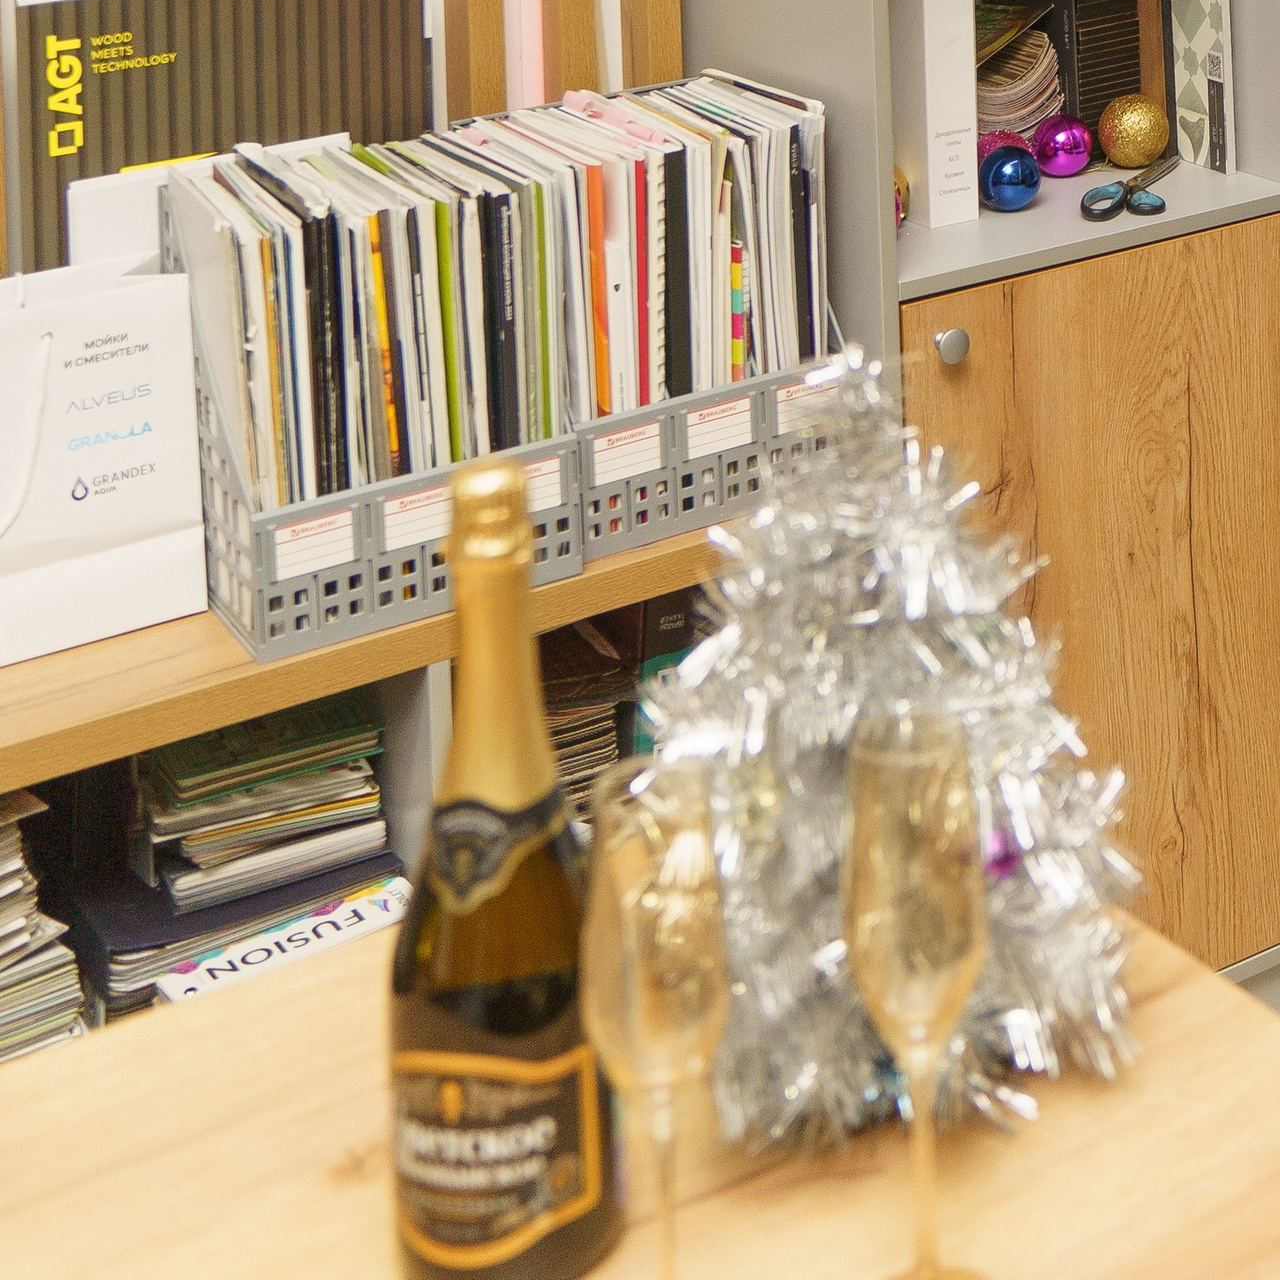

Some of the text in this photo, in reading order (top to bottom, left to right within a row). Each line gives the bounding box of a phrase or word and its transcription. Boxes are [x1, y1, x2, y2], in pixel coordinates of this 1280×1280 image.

[90, 32, 133, 46] WOOD
[91, 45, 134, 60] MEETS
[91, 52, 177, 75] TECHNOLOGY
[46, 35, 83, 115] AGT
[84, 333, 129, 350] МОЙКИ
[64, 343, 150, 369] И СМЕСИТЕЛИ
[66, 383, 152, 415] ALVEUS
[706, 404, 738, 418] BRAUBERG
[614, 429, 647, 444] BRAUBERG
[93, 462, 157, 487] GRANDEX
[94, 486, 117, 496] AQUA
[408, 491, 444, 506] BRAUBERG
[300, 519, 338, 534] BRAUBERG
[205, 908, 367, 980] FUSION
